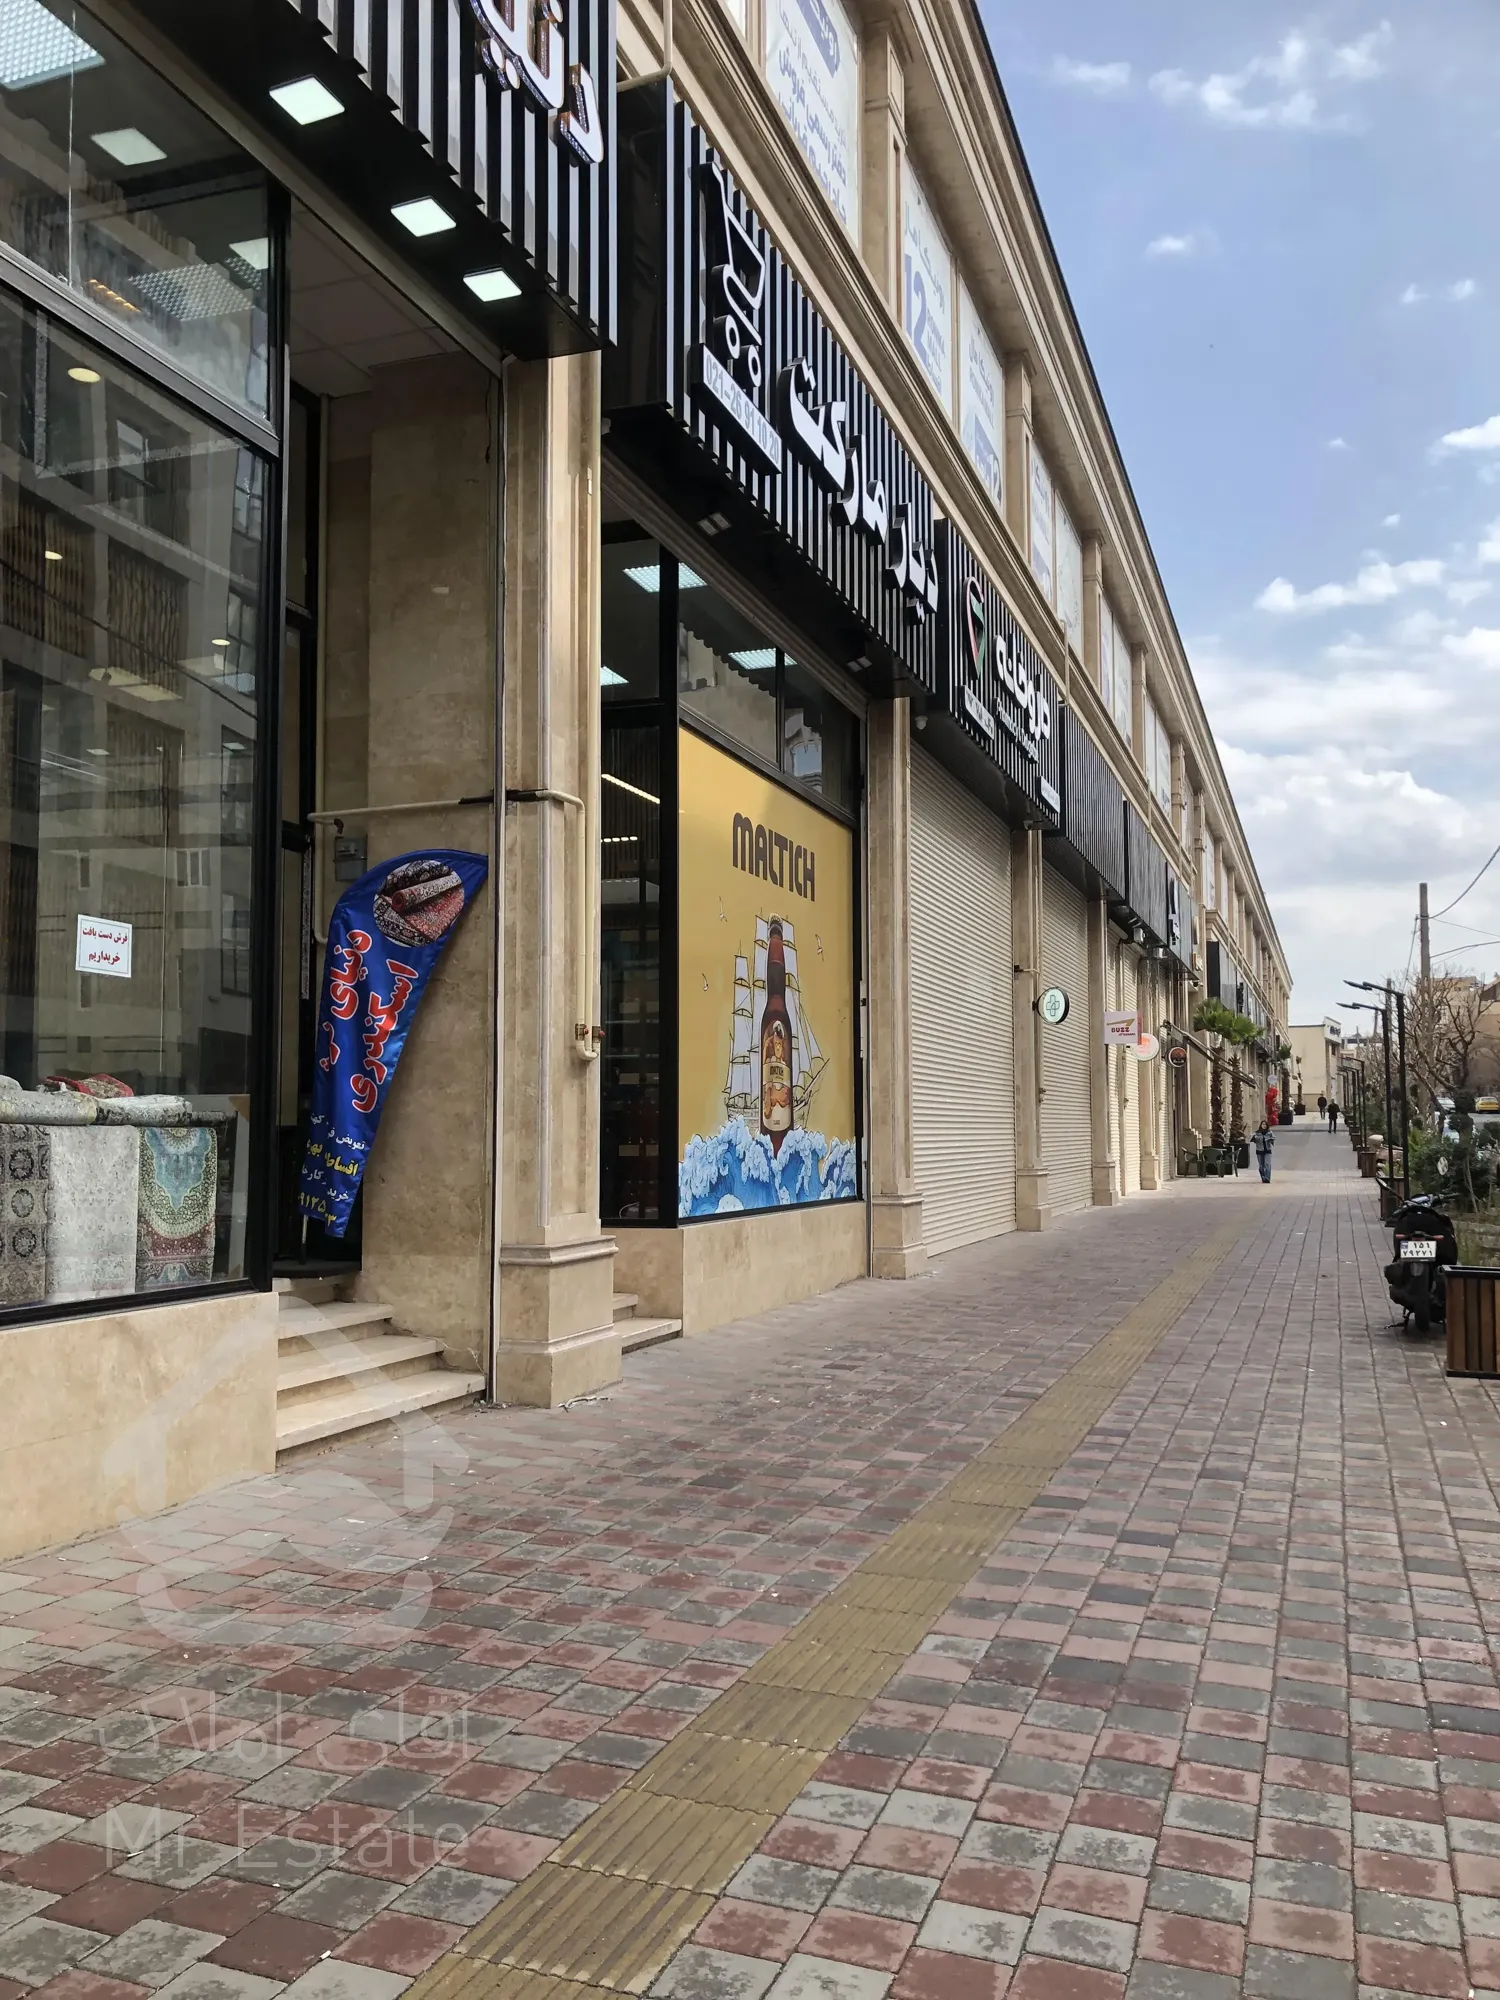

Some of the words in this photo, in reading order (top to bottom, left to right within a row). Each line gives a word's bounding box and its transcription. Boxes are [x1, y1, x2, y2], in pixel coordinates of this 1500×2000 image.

[779, 46, 805, 108] فروش
[806, 104, 830, 164] رسمی
[831, 143, 846, 187] دفتر
[905, 253, 927, 368] 12
[706, 354, 742, 420] 021-26
[744, 400, 755, 436] 91
[757, 416, 767, 450] 10
[769, 431, 780, 464] 20
[789, 356, 889, 544] مارکت
[894, 502, 939, 624] دیار
[996, 632, 1050, 740] داروخانه
[732, 811, 816, 902] MALTICH
[82, 926, 97, 939] بافت
[88, 950, 121, 965] خریداریم
[98, 930, 113, 939] دست
[113, 932, 128, 944] فرش
[330, 929, 373, 1020] دنیای
[350, 959, 419, 1114] اسکندری
